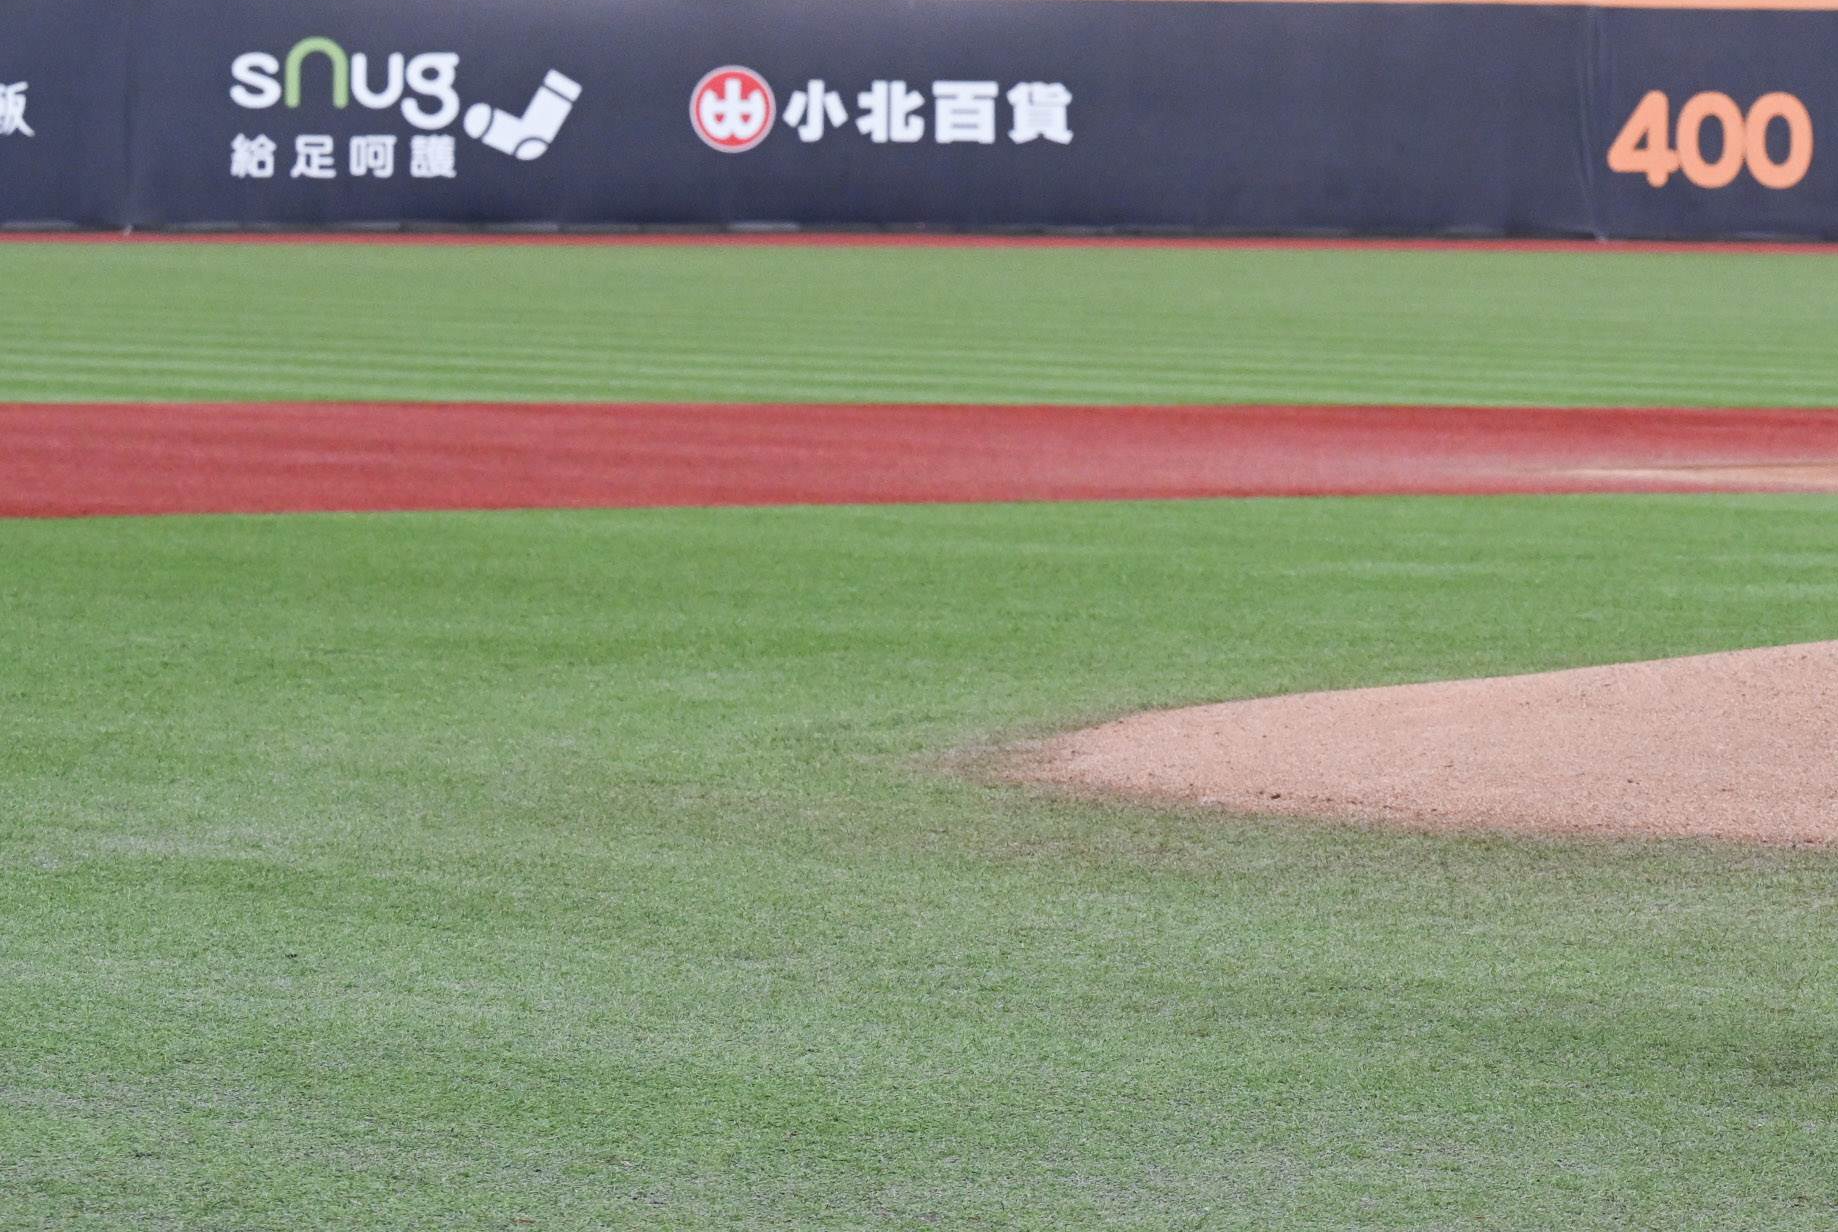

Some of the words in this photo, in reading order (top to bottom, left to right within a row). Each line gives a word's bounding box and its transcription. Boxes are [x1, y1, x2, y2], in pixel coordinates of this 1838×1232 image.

[230, 36, 459, 129] snug
[782, 79, 1074, 145] 小北百貨
[230, 133, 457, 178] 給足呵護
[1607, 90, 1814, 190] 400
